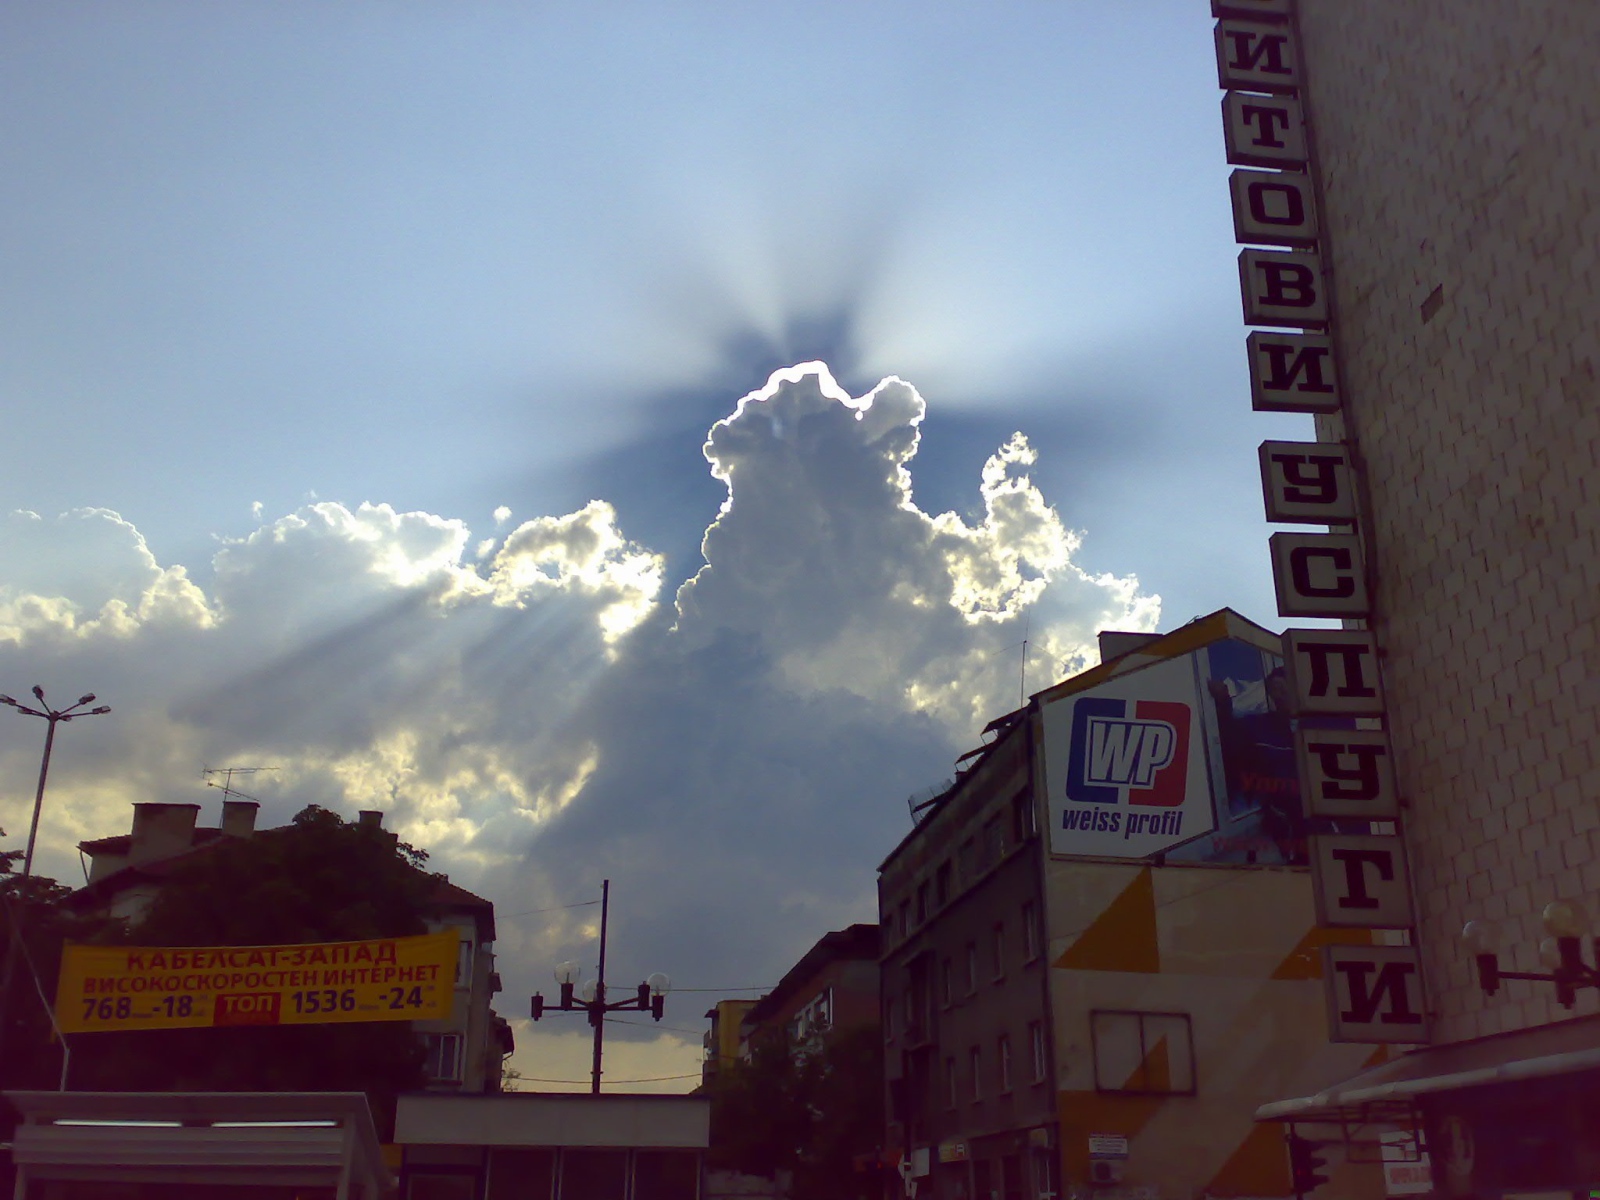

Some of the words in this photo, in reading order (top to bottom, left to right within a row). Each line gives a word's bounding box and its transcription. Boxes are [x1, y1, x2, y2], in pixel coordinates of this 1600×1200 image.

[1225, 0, 1334, 394] ИТОВИ
[1090, 720, 1173, 785] WP
[1271, 453, 1422, 1025] УСЛУГИ
[1062, 807, 1121, 832] weiss
[1124, 811, 1183, 840] profil
[127, 942, 397, 971] КАБЕЛСАТ-ЗАПАД
[83, 970, 317, 994] ВИСОКОСКОРОСТЕН
[323, 964, 440, 986] ИНТЕРНЕТ
[83, 996, 131, 1021] 768
[224, 994, 273, 1013] ТОП
[291, 989, 356, 1014] 1536
